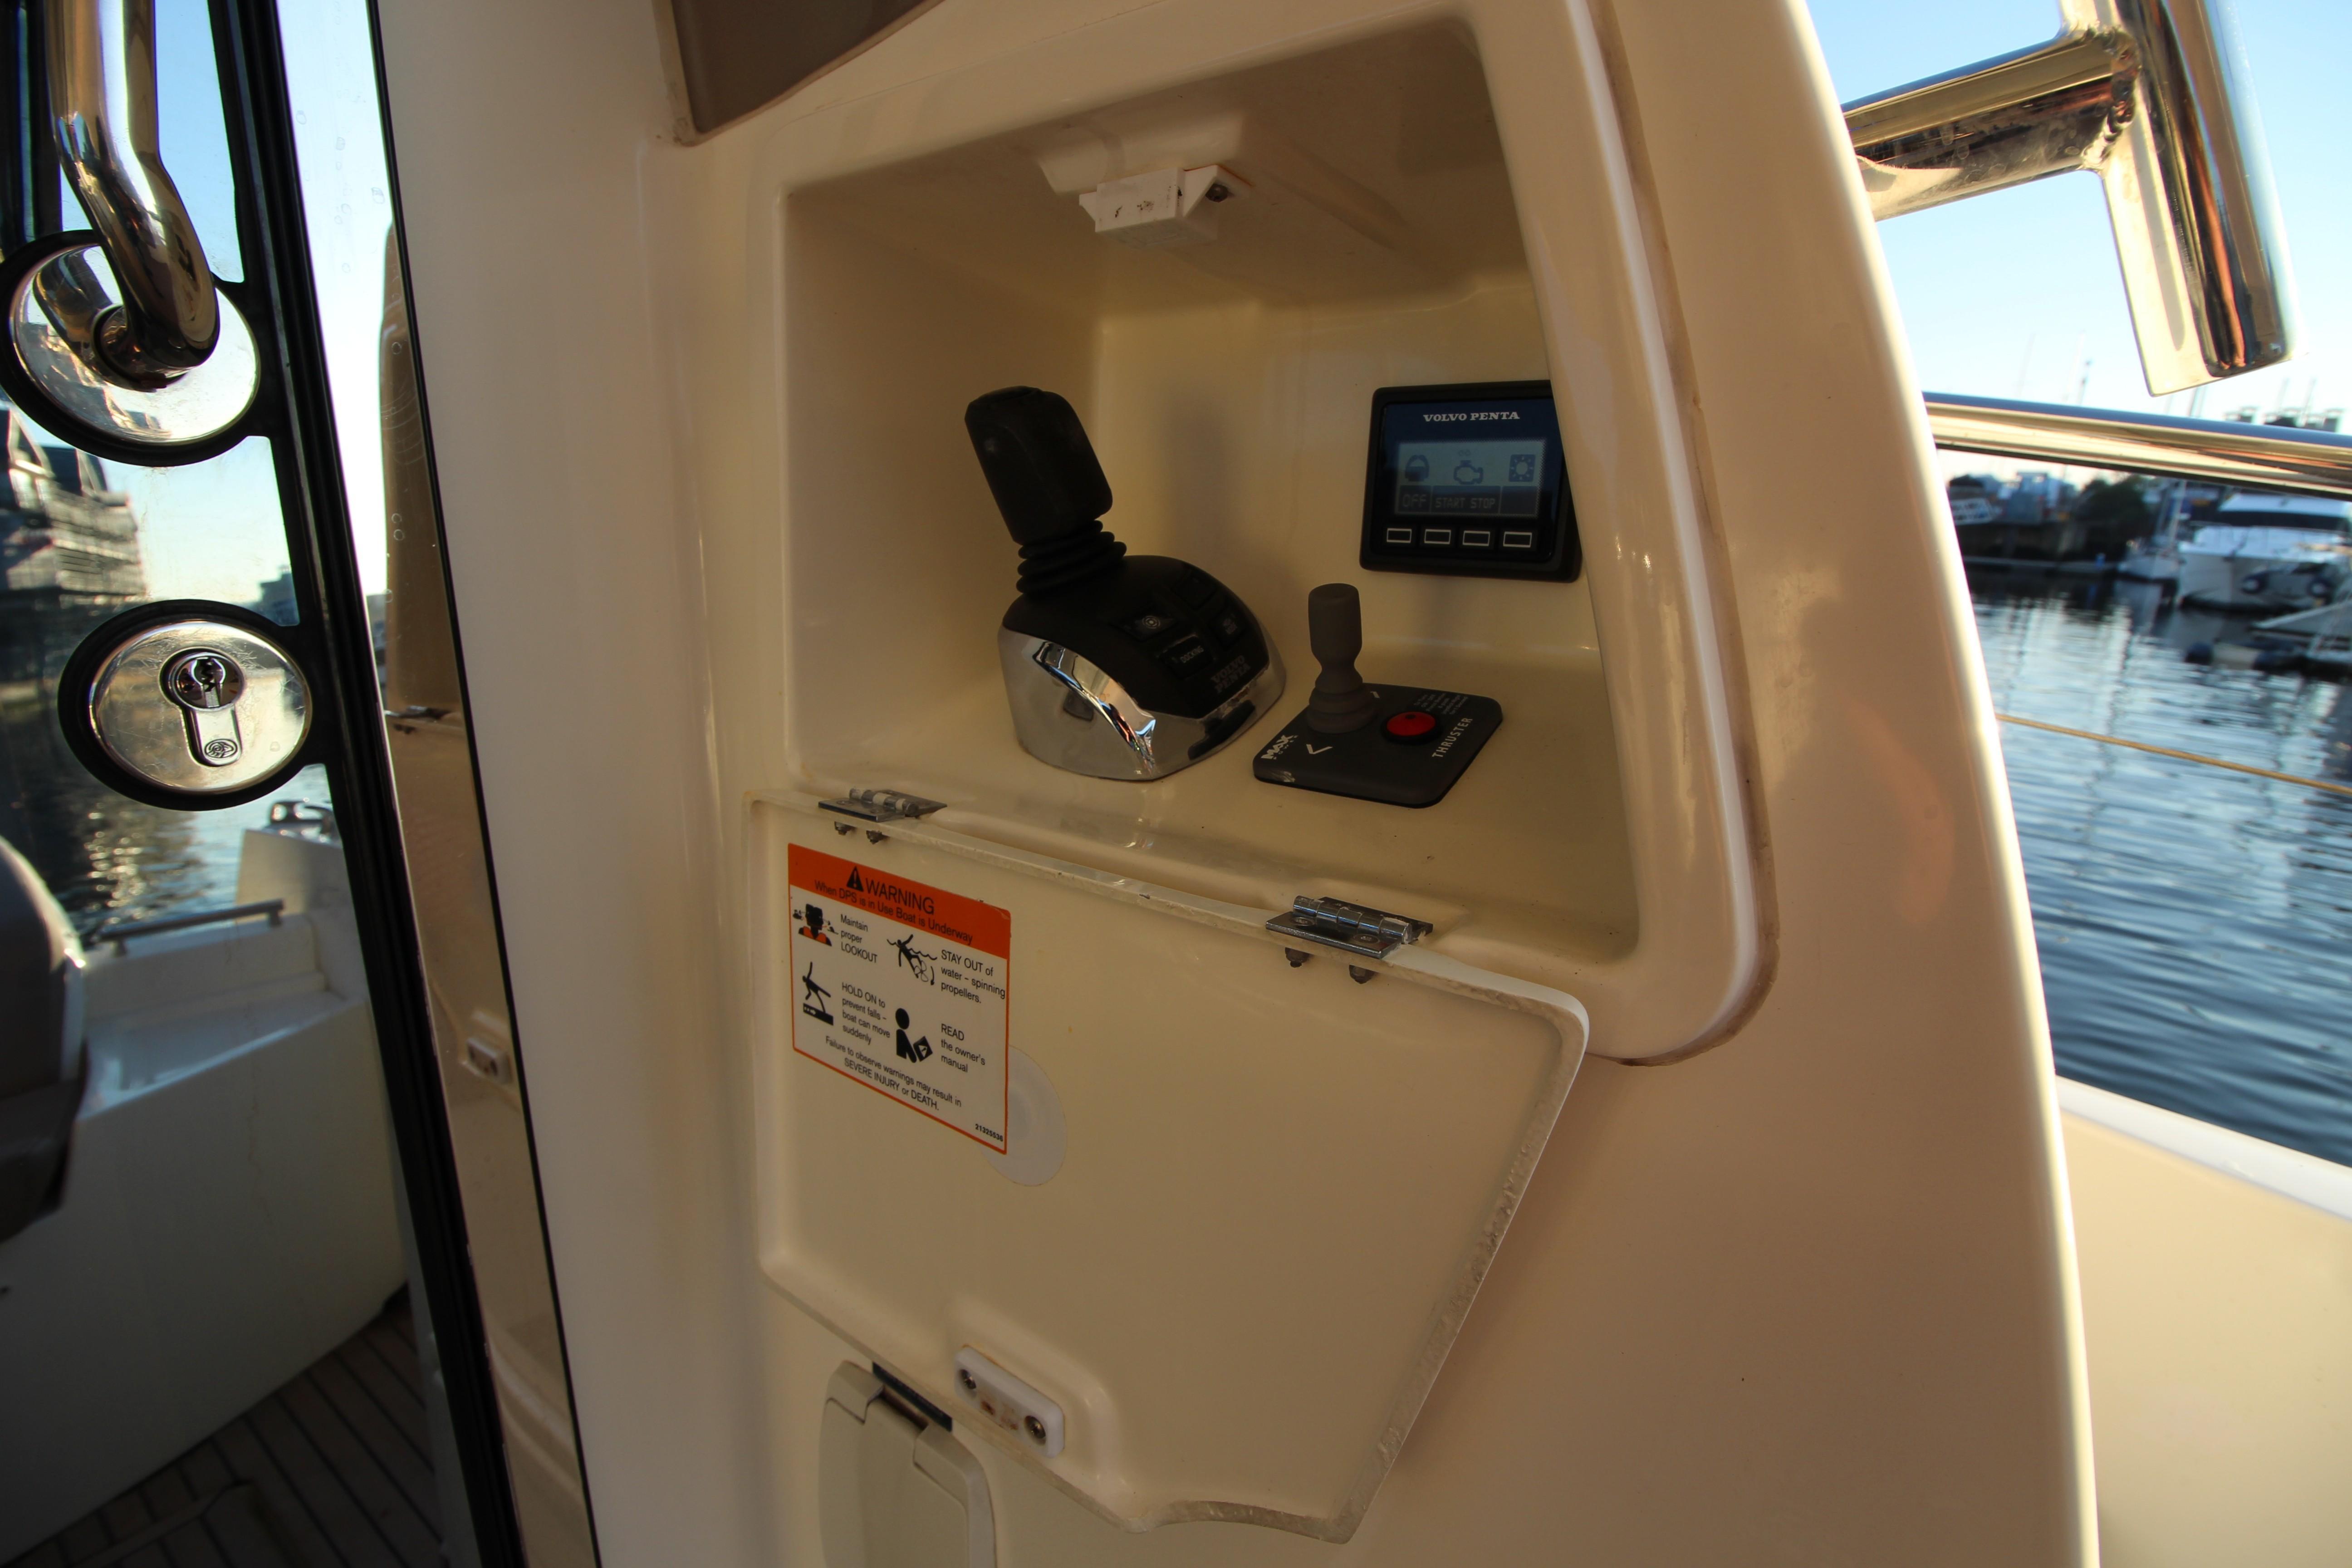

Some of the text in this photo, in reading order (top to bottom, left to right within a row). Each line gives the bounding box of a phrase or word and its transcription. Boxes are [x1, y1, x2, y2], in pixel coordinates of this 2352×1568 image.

[1423, 411, 1520, 422] VOLVO PENTA
[1402, 493, 1496, 510] OFF START STOP
[1210, 655, 1246, 683] VOLVO
[1214, 662, 1252, 694] PENTA
[1261, 735, 1294, 759] MAX
[1432, 718, 1473, 757] THRUSTER
[866, 878, 934, 915] WARNING
[814, 880, 973, 946] When DPS is in Use Boat is Underway
[841, 913, 868, 932] Maintain
[841, 930, 862, 944] proper
[841, 941, 878, 963] LOOKOUT
[941, 949, 993, 977] STAY OUT of
[842, 981, 885, 1008] HOLD ON to
[941, 966, 962, 980] water
[971, 978, 1005, 1000] spinning
[941, 982, 981, 1004] propellers.
[843, 998, 866, 1014] prevent
[867, 1006, 881, 1020] falls
[843, 1009, 890, 1039] boat can move
[843, 1024, 872, 1045] suddenly
[941, 1023, 965, 1041] READ
[941, 1039, 985, 1066] the owner's
[941, 1055, 968, 1073] manual
[826, 1035, 961, 1107] Failure to observe warnings may result in
[844, 1057, 939, 1111] SEVERE INJURY or DEATH.
